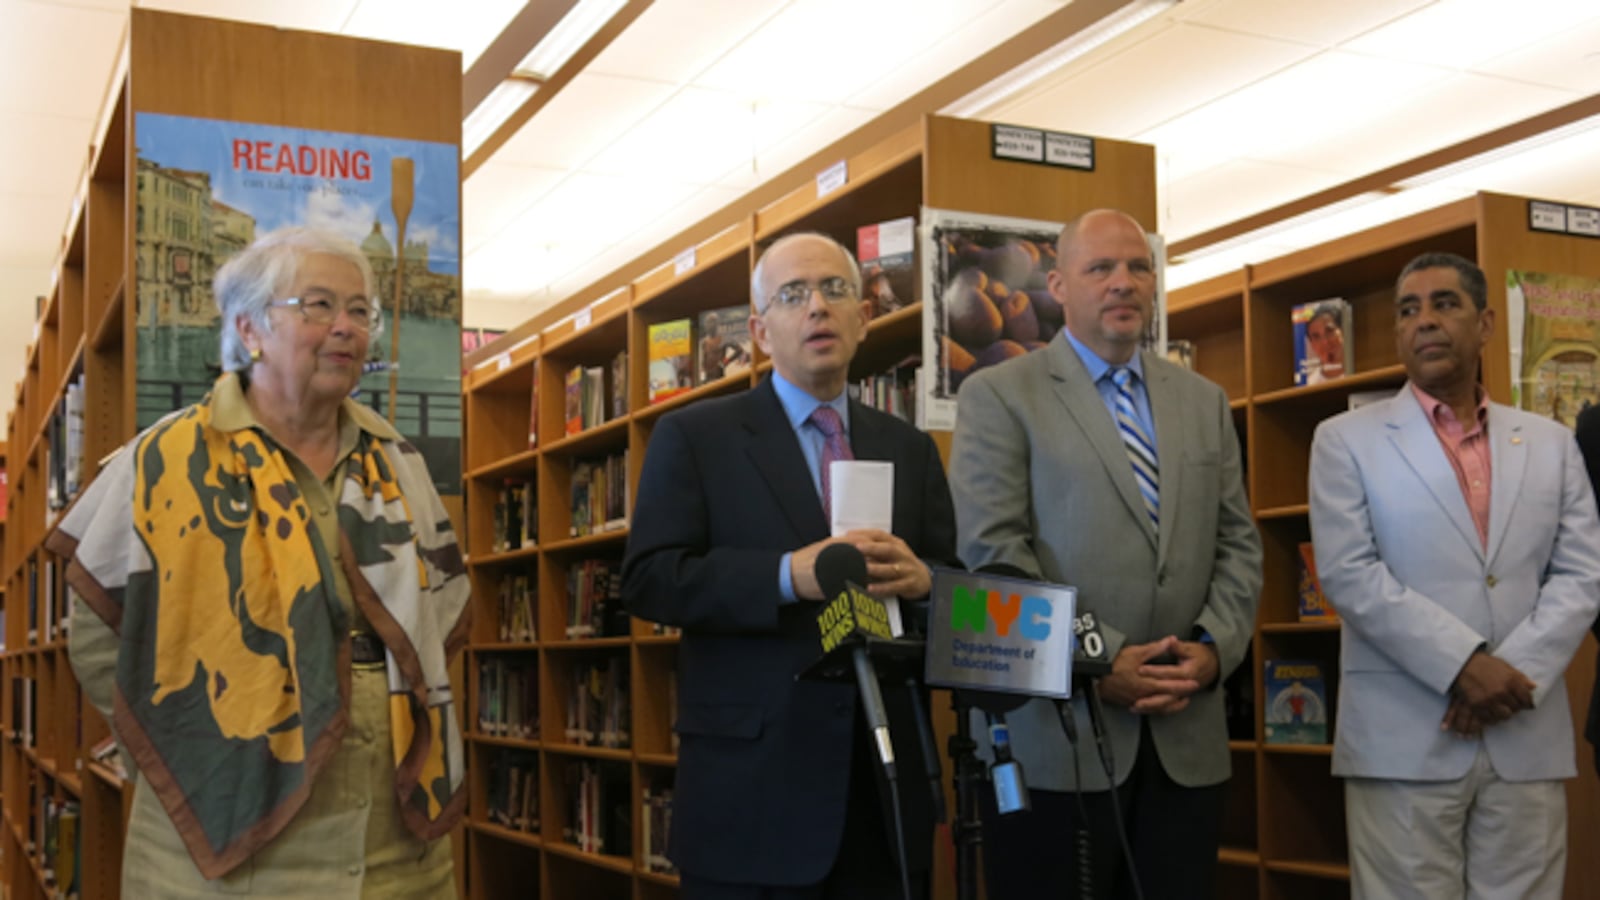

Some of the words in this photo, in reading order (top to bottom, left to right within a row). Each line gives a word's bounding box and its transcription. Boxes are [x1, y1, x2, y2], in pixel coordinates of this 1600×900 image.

[232, 138, 372, 181] READING
[816, 591, 850, 636] 1010
[849, 587, 888, 624] 1010
[951, 584, 1053, 641] NYC
[821, 611, 855, 653] WINS
[952, 638, 1021, 659] Department
[1023, 648, 1036, 659] of
[951, 655, 1010, 672] Education
